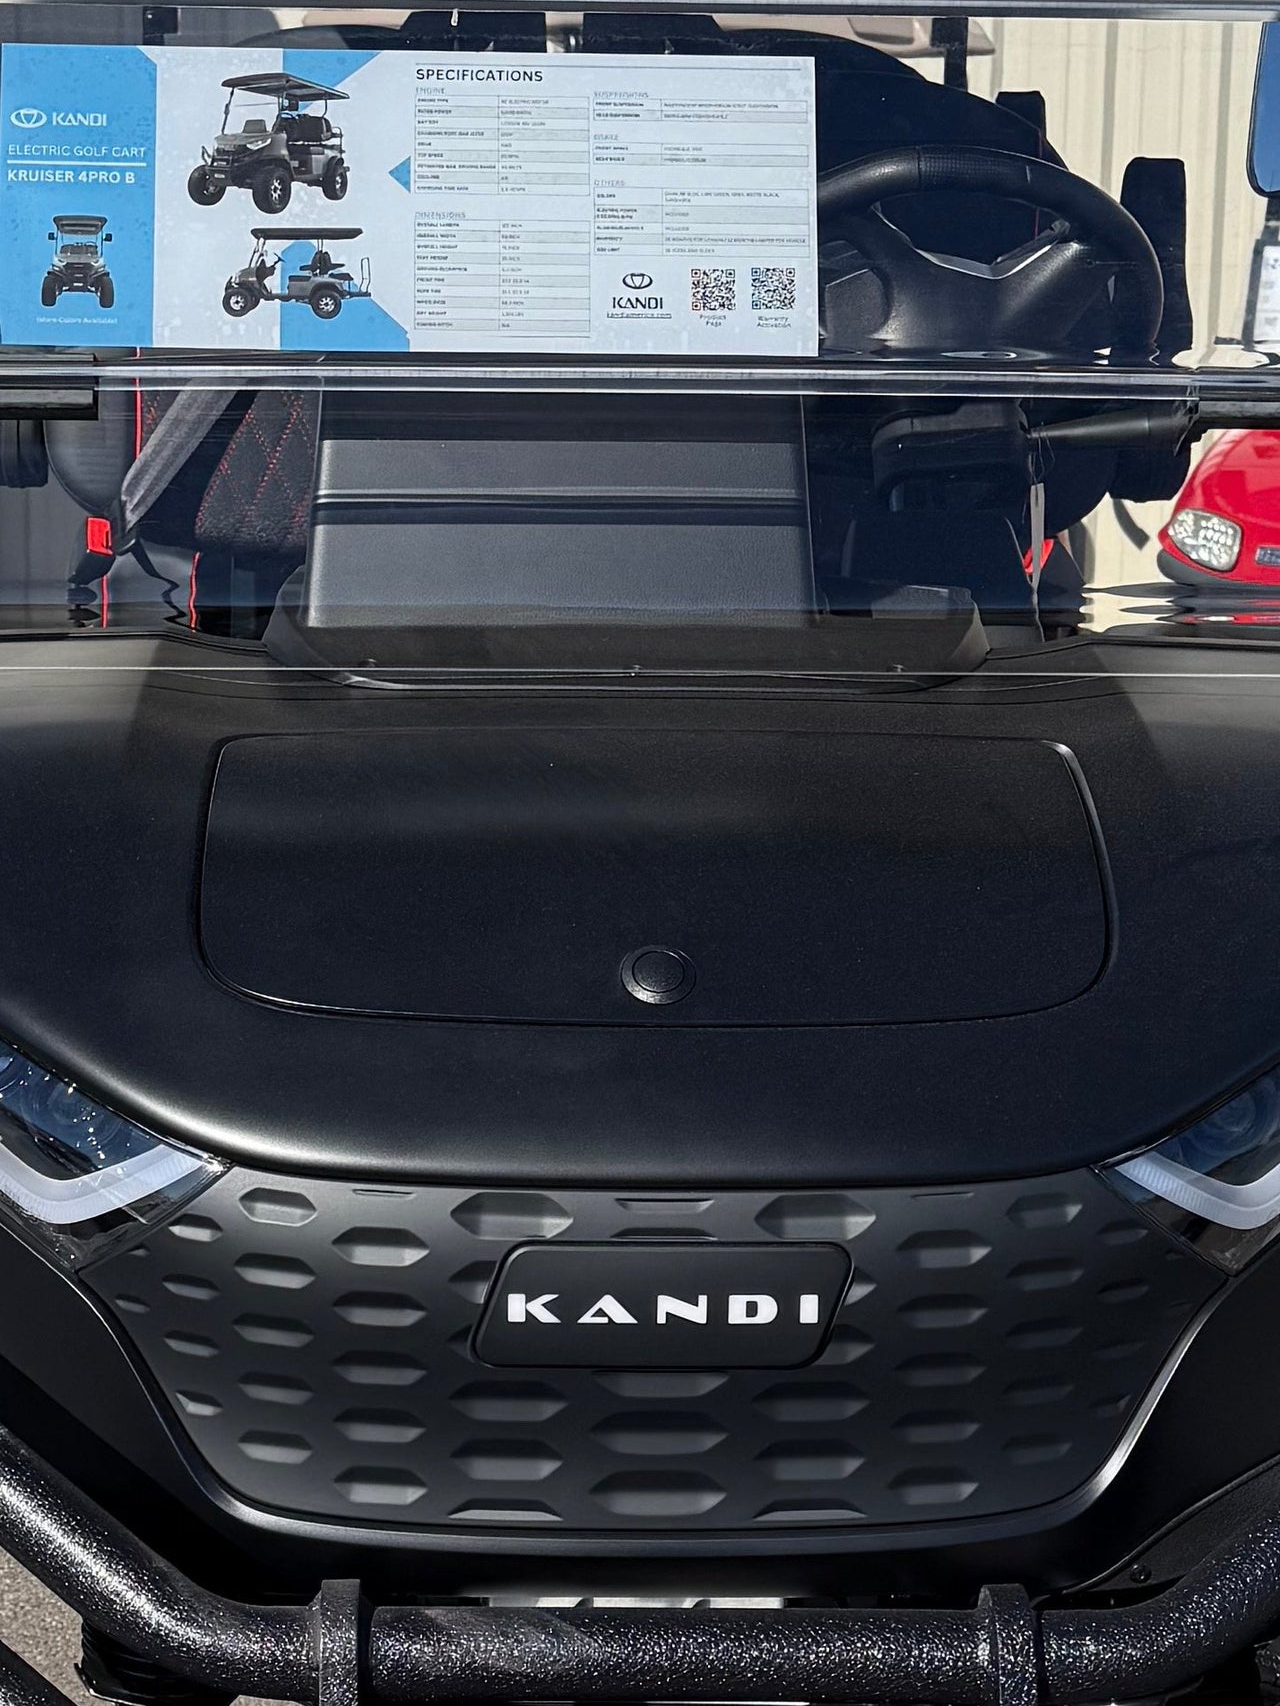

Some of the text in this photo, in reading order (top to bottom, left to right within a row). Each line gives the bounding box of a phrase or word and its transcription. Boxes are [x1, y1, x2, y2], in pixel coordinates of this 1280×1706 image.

[415, 68, 544, 82] SPECIFICATIONS
[52, 112, 108, 127] KANDI
[8, 144, 146, 158] ELECTRIC GOLF CART
[7, 169, 136, 184] KRUISER 4PRO B
[415, 211, 467, 219] DIMENSIONS
[612, 296, 664, 310] KANDI
[506, 1292, 820, 1325] KANDI
